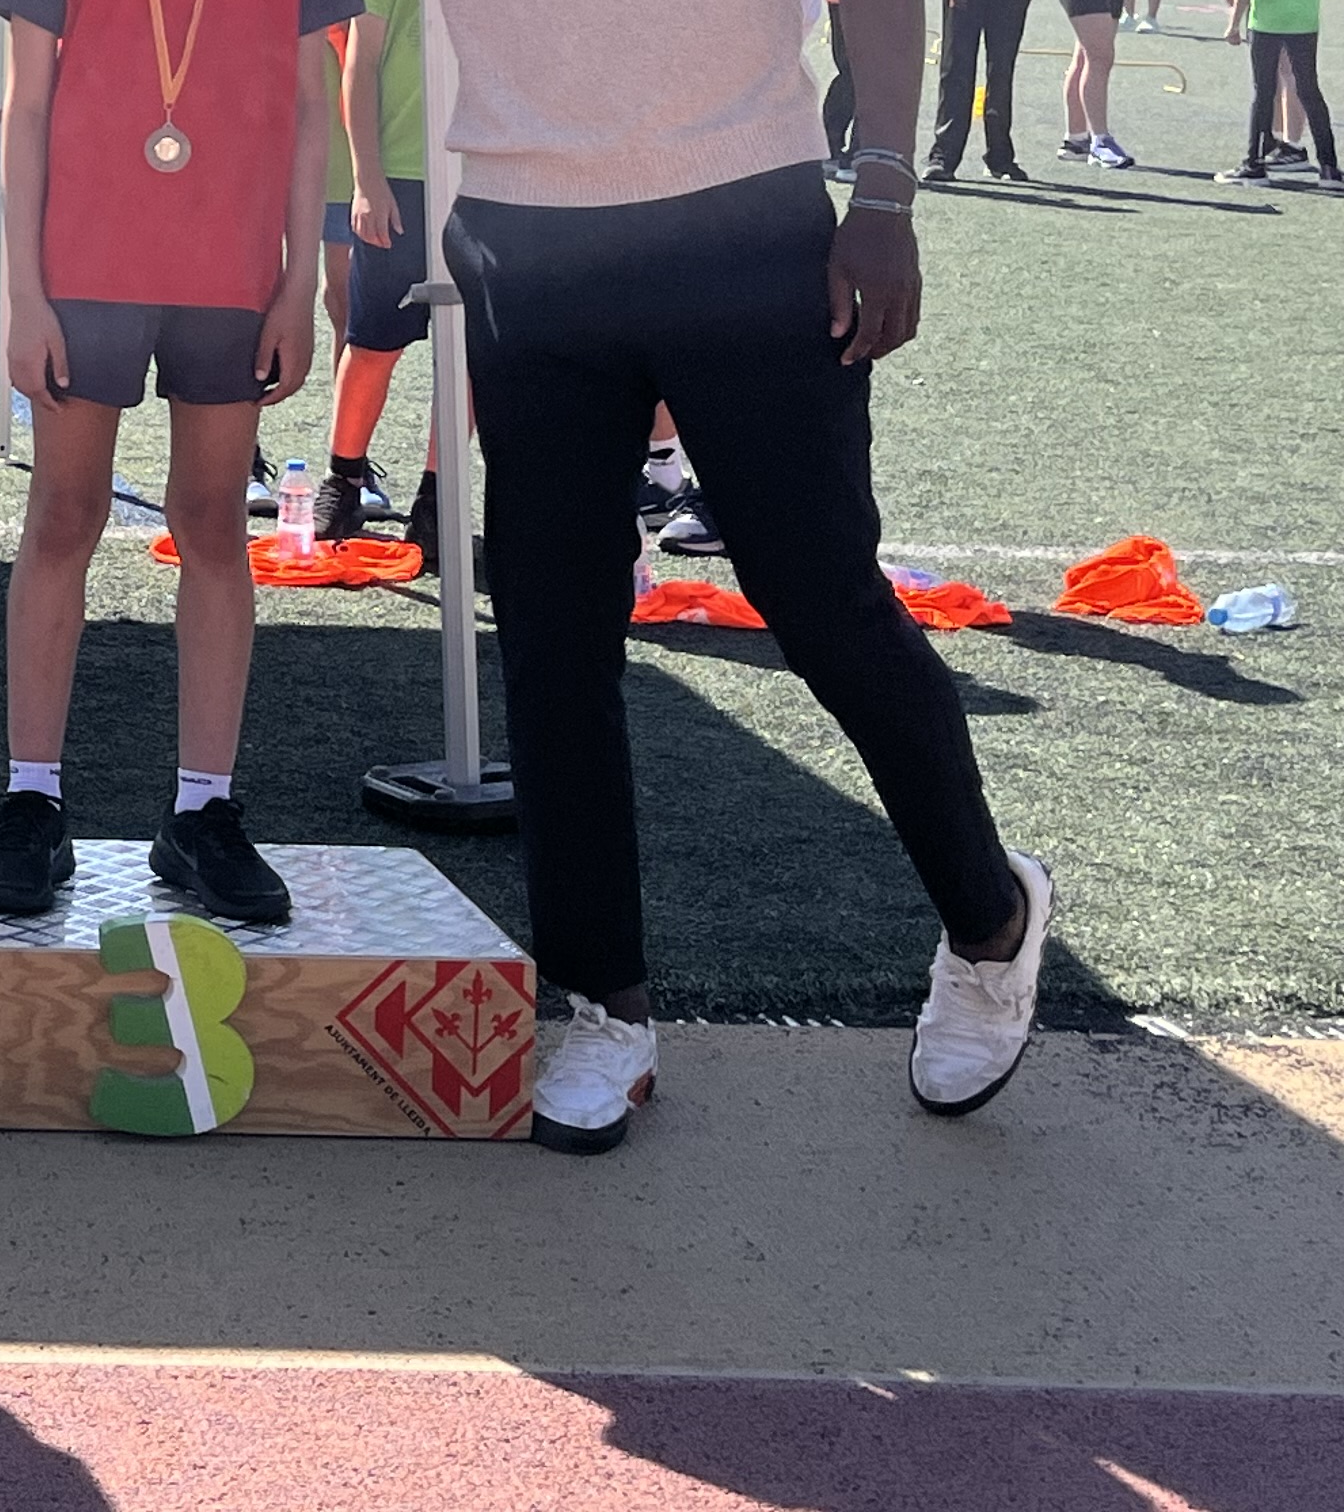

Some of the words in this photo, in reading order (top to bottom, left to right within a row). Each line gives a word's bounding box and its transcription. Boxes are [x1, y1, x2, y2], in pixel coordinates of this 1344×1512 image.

[89, 913, 254, 1136] 3
[324, 1025, 386, 1086] AJUNTAMENT
[383, 1085, 399, 1101] DE
[397, 1099, 431, 1137] LLEIDA
